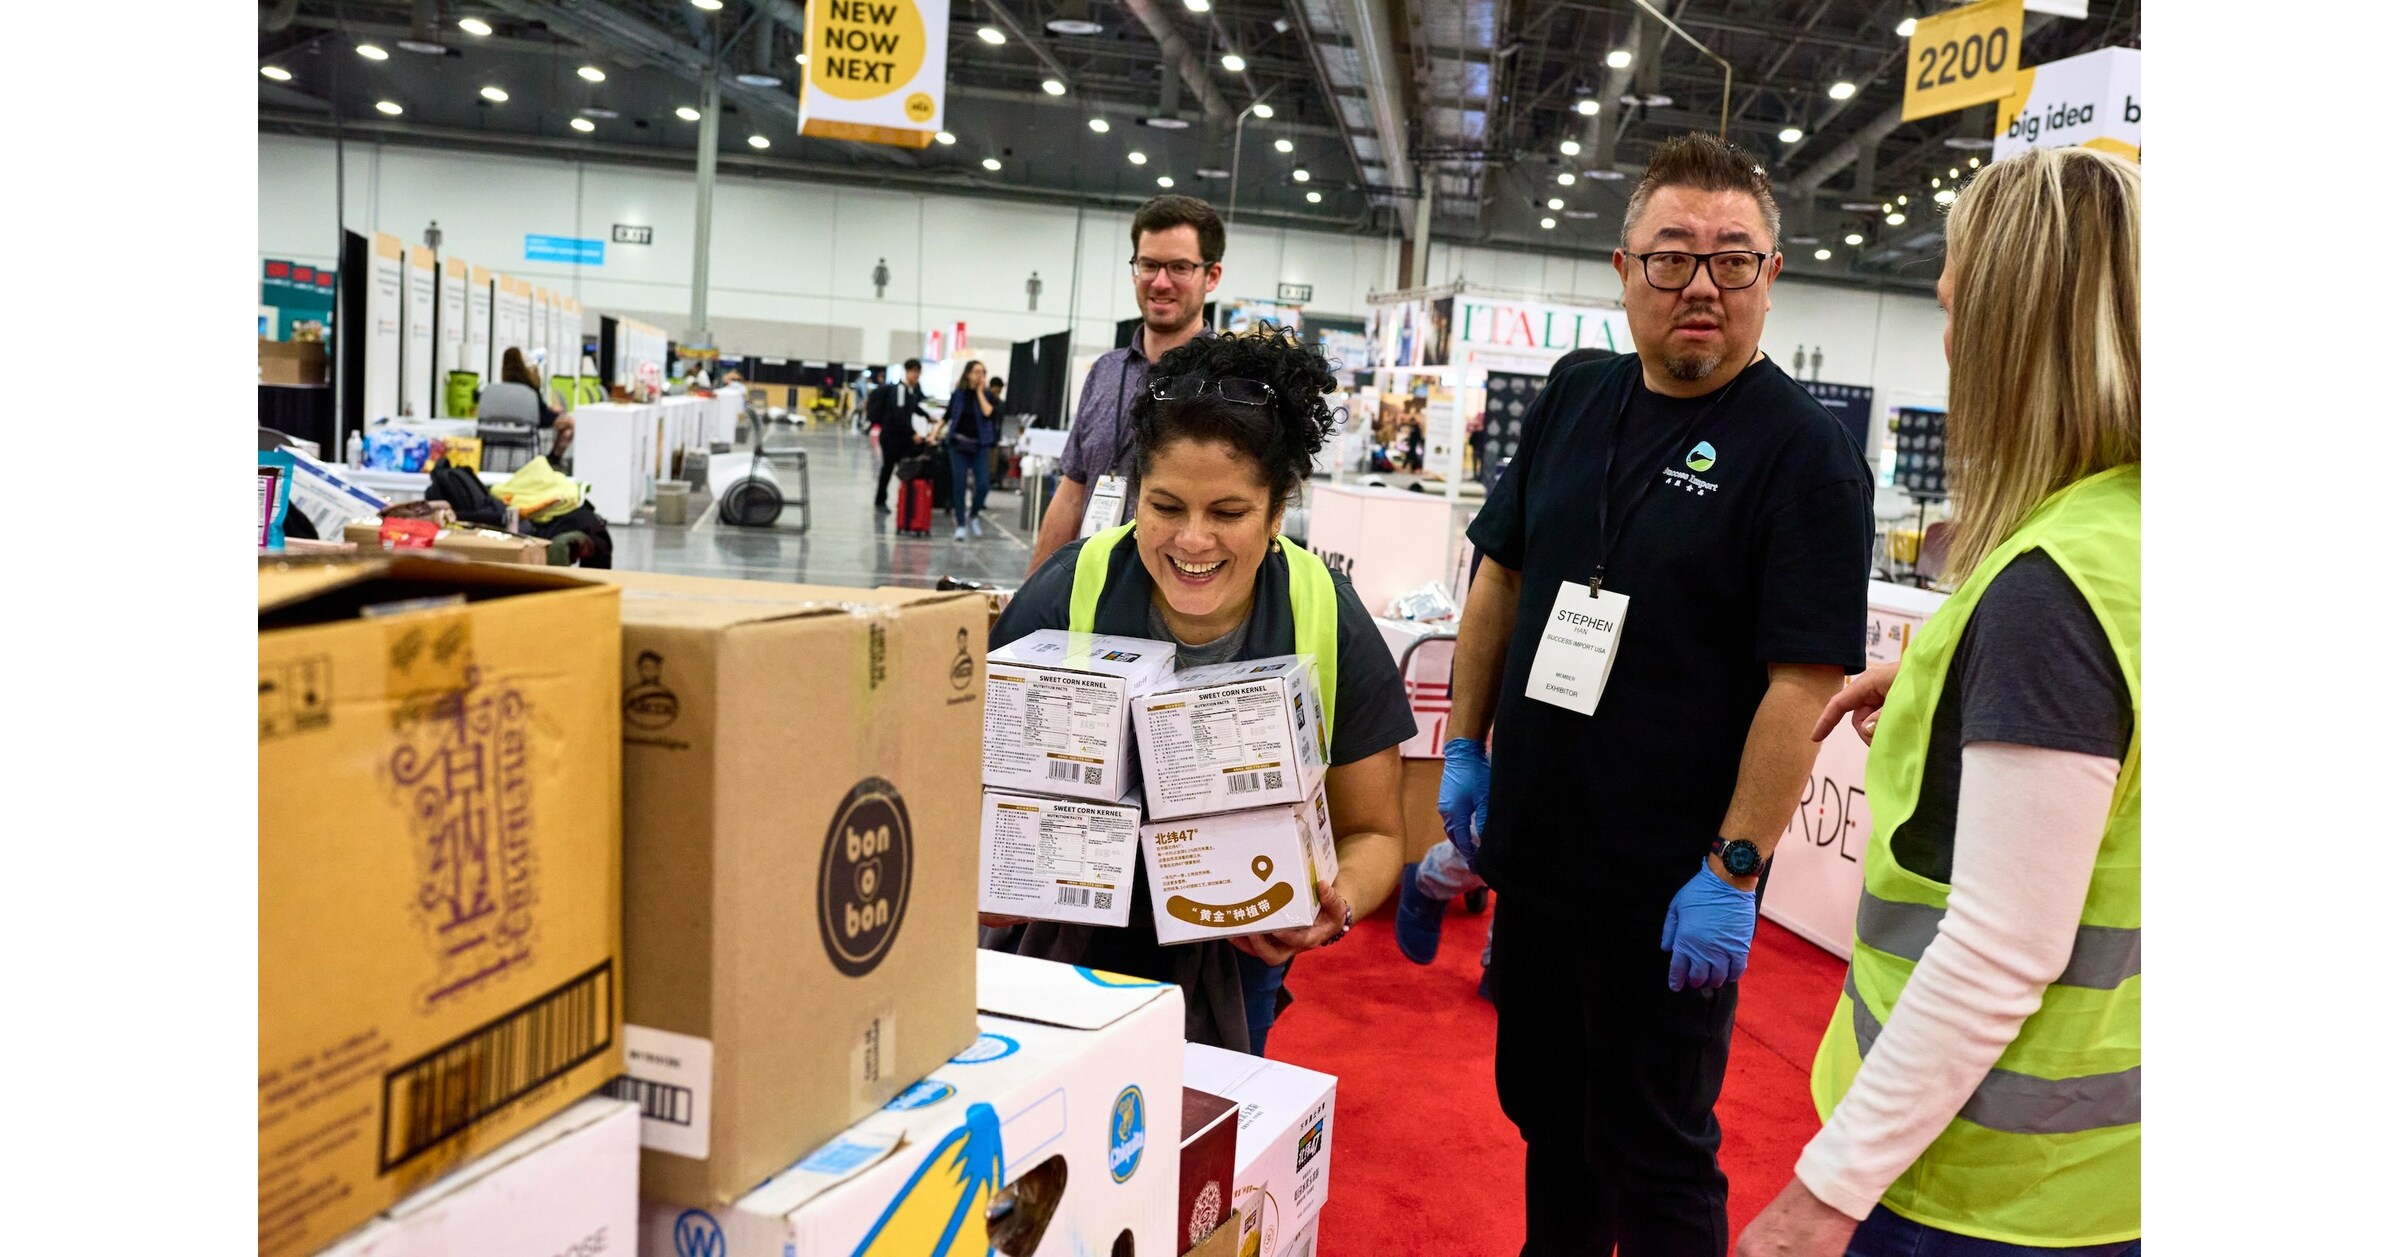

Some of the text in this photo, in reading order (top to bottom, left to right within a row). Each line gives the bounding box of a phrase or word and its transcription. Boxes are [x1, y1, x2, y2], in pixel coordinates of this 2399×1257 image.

[830, 0, 898, 26] NEW
[825, 27, 900, 55] NOW
[826, 56, 896, 84] NEXT
[1916, 26, 2009, 91] 2200
[2008, 102, 2094, 143] big idea
[1461, 303, 1617, 352] ITALIA
[1557, 609, 1613, 633] STEPHEN
[1574, 626, 1588, 635] HAN
[1547, 634, 1606, 654] SUCCESS IMPORT USA
[1039, 675, 1107, 689] SWEET CORN KERNEL
[1556, 672, 1576, 682] MEMBER
[1198, 685, 1267, 701] SWEET CORN KERNEL
[1546, 683, 1578, 698] EXHIBITOR
[1053, 805, 1123, 818] SWEET CORN KERNEL
[846, 825, 890, 863] bon
[1154, 828, 1198, 845] 北纬47°
[861, 867, 876, 895] o
[844, 897, 889, 939] bon
